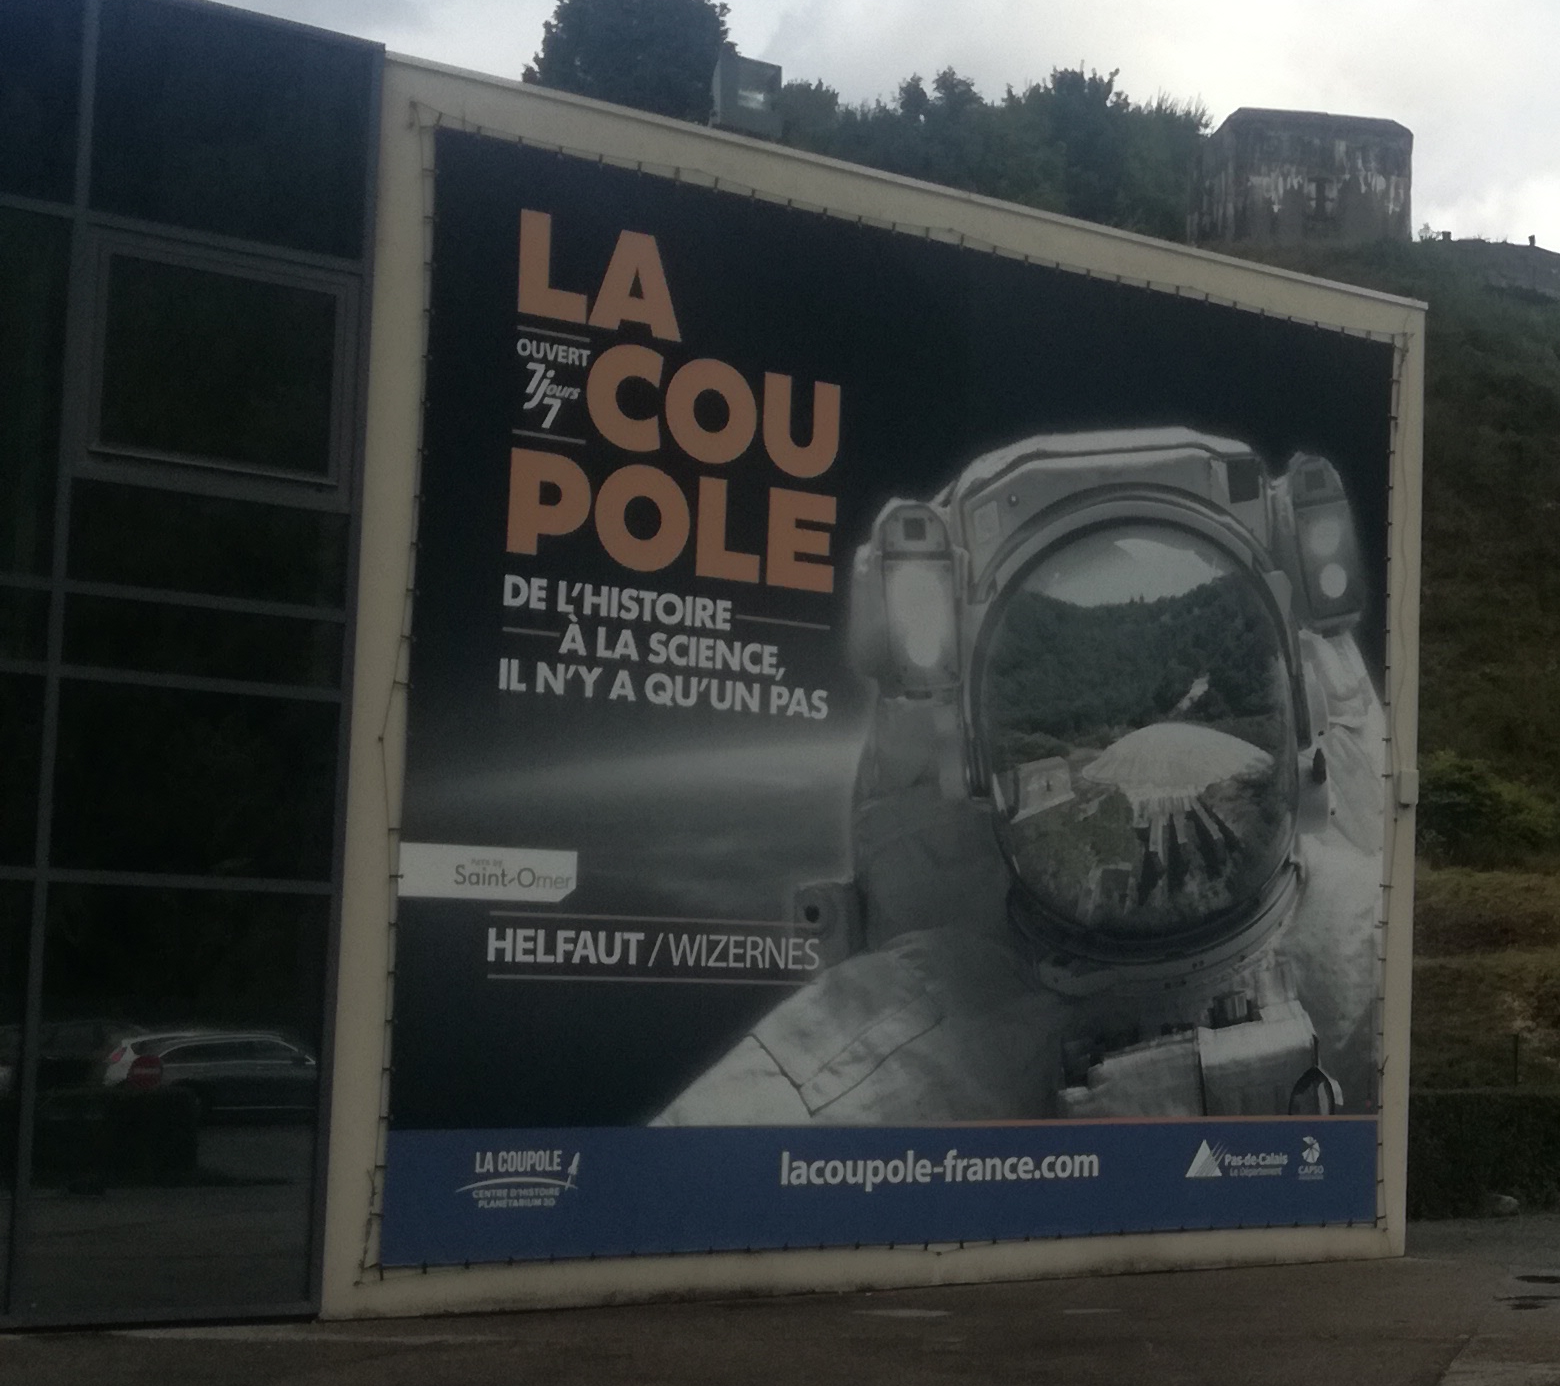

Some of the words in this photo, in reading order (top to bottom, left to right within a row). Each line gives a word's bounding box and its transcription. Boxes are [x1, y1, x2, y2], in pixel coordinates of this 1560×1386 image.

[517, 208, 682, 342] LA
[516, 338, 591, 367] OUVERT
[586, 344, 841, 478] COU
[506, 447, 837, 593] POLE
[503, 574, 548, 610] DE
[557, 580, 733, 631] L'HISTOIRE
[559, 614, 587, 656] À
[596, 626, 640, 661] LA
[647, 631, 786, 681] SCIENCE,
[498, 657, 527, 692] IL
[535, 661, 603, 698] N'Y
[608, 669, 637, 701] A
[644, 673, 761, 714] QU'UN
[769, 685, 829, 720] PAS
[454, 864, 573, 889] Saint-Omer
[487, 927, 645, 965] HELFAUT
[668, 932, 820, 970] WIZERNES
[475, 1151, 494, 1173] LA
[497, 1149, 563, 1172] COUPOLE
[781, 1149, 1100, 1192] lacoupole-france.com
[1225, 1152, 1288, 1166] Pas-de-Calais
